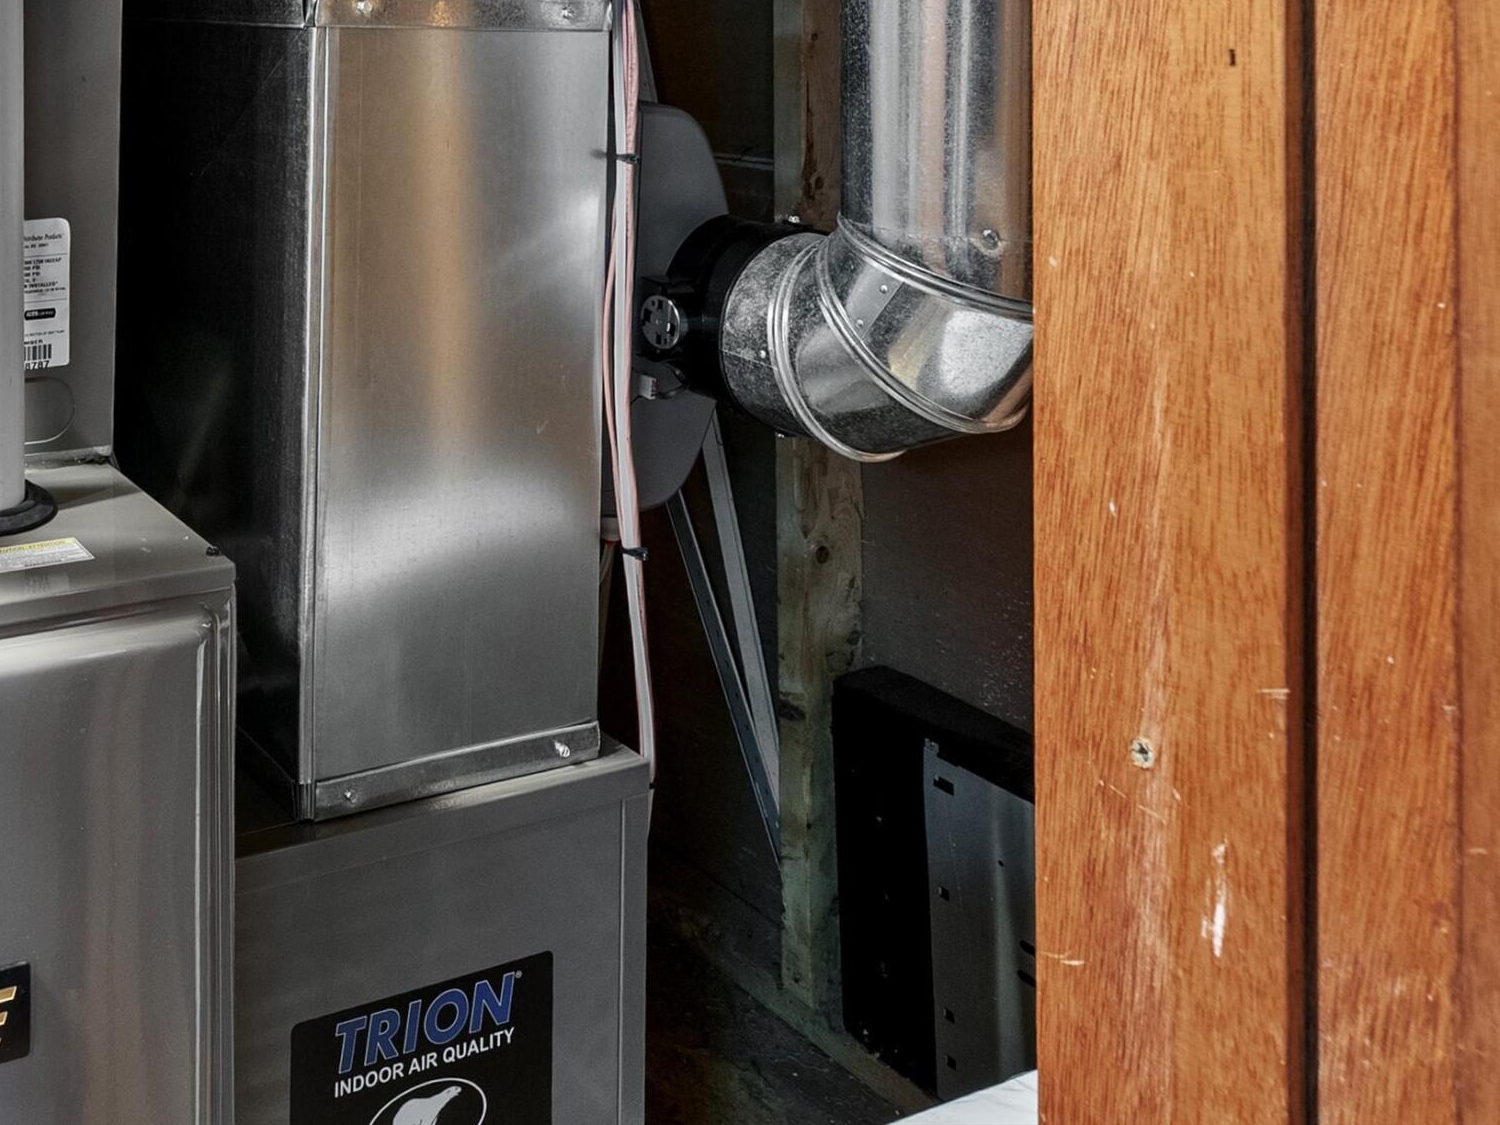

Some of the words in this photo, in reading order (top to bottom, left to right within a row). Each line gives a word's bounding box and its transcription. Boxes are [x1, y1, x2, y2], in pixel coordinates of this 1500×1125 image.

[334, 1063, 404, 1098] INDOOR
[408, 1052, 438, 1075] AIR
[443, 1027, 515, 1063] QUALITY
